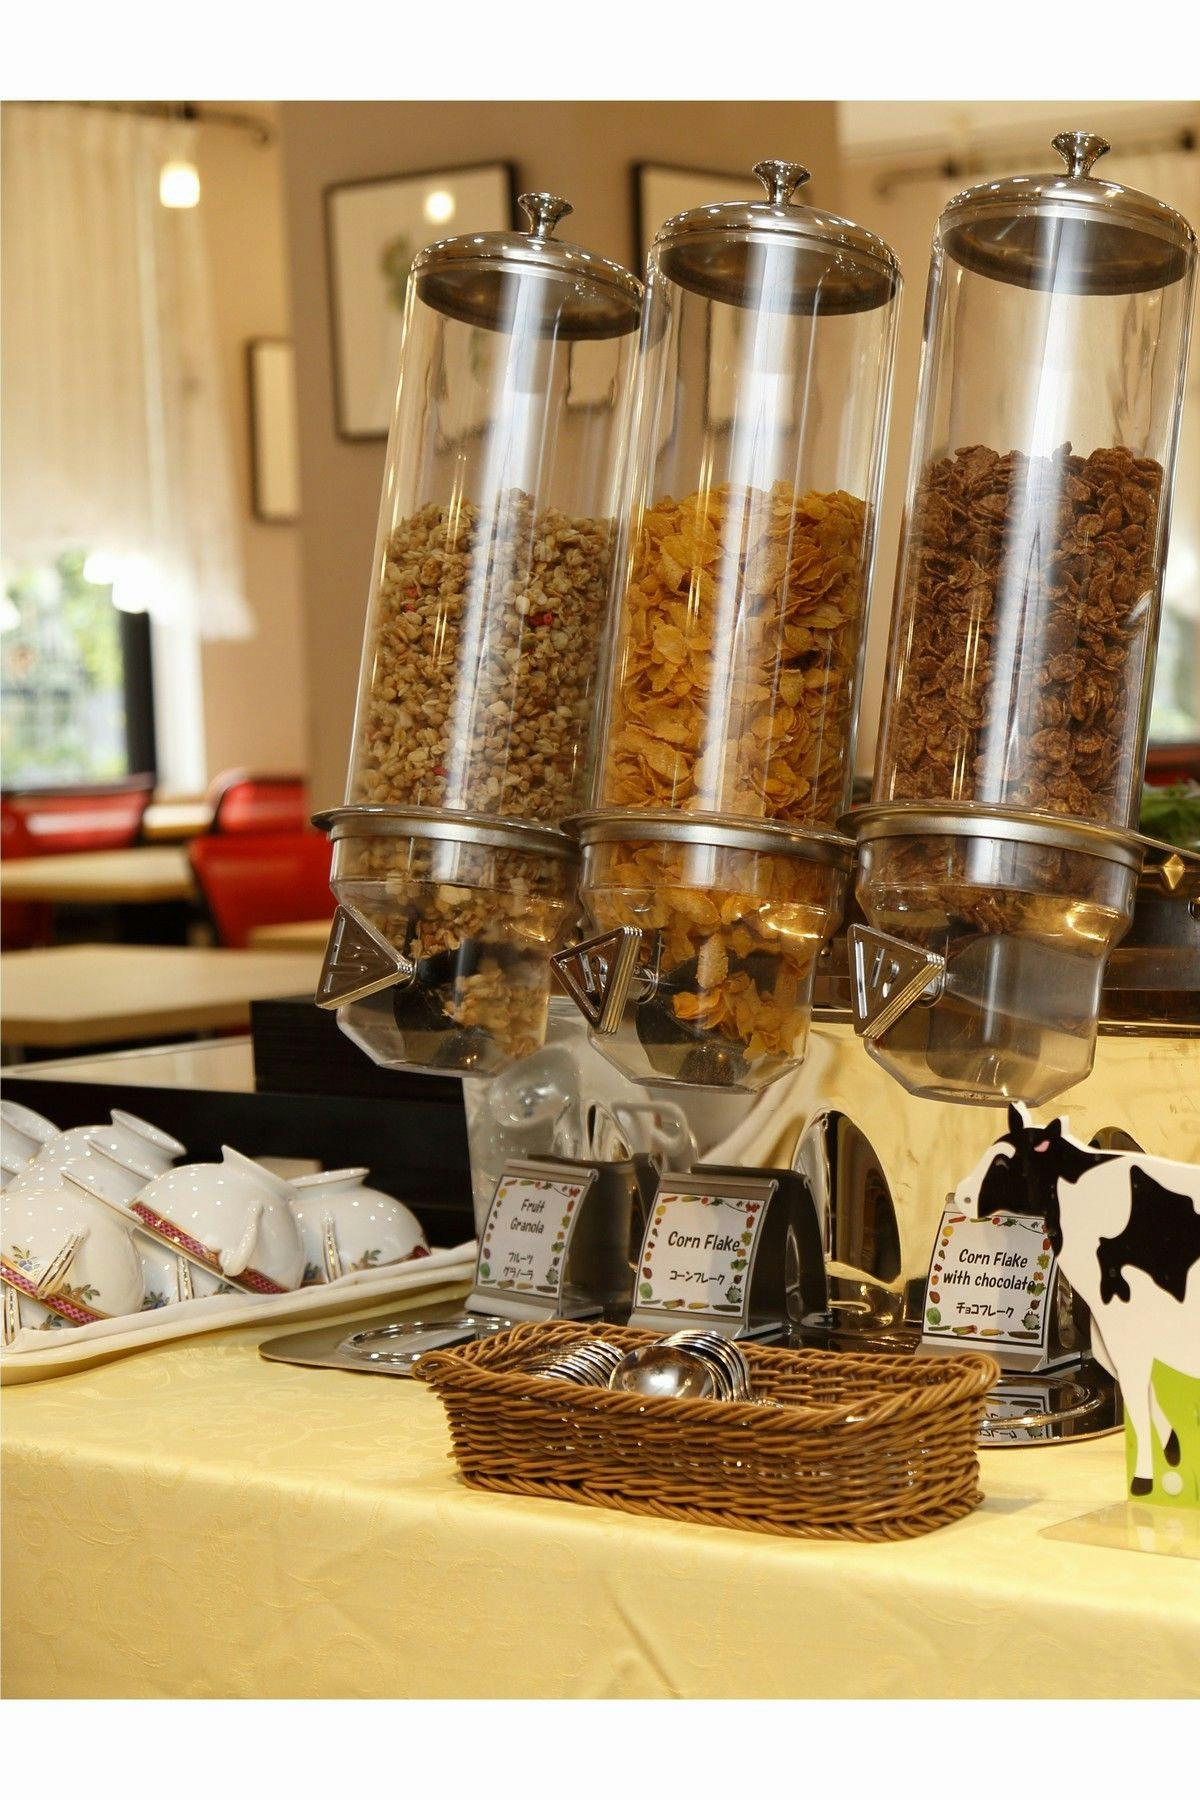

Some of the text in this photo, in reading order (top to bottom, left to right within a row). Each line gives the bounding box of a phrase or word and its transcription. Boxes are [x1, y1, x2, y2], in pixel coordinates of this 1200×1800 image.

[520, 1198, 546, 1214] Fruit
[510, 1217, 545, 1234] Granola
[668, 1231, 741, 1252] Corn Flake
[508, 1251, 534, 1265] フルーツ
[959, 1248, 1029, 1268] Corn Flake
[669, 1270, 726, 1285] コーンフレーク
[943, 1270, 971, 1285] with
[956, 1301, 1015, 1319] チョコフレーク
